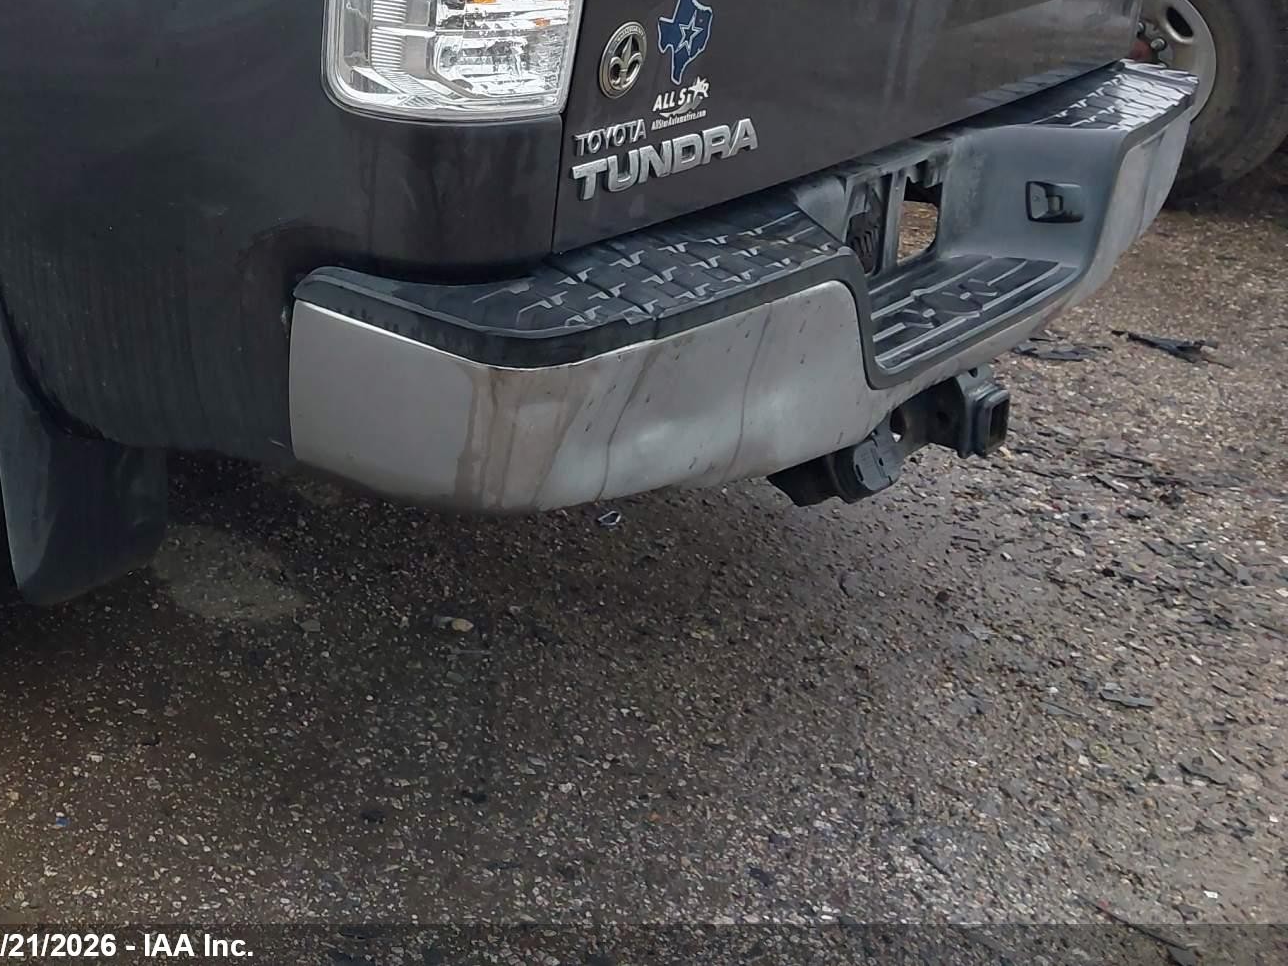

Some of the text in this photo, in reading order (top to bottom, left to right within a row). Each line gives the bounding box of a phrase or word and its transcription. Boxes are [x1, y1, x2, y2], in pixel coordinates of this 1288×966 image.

[652, 90, 676, 112] ALL
[574, 118, 647, 156] TOYOTA
[572, 117, 759, 201] TUNDRA
